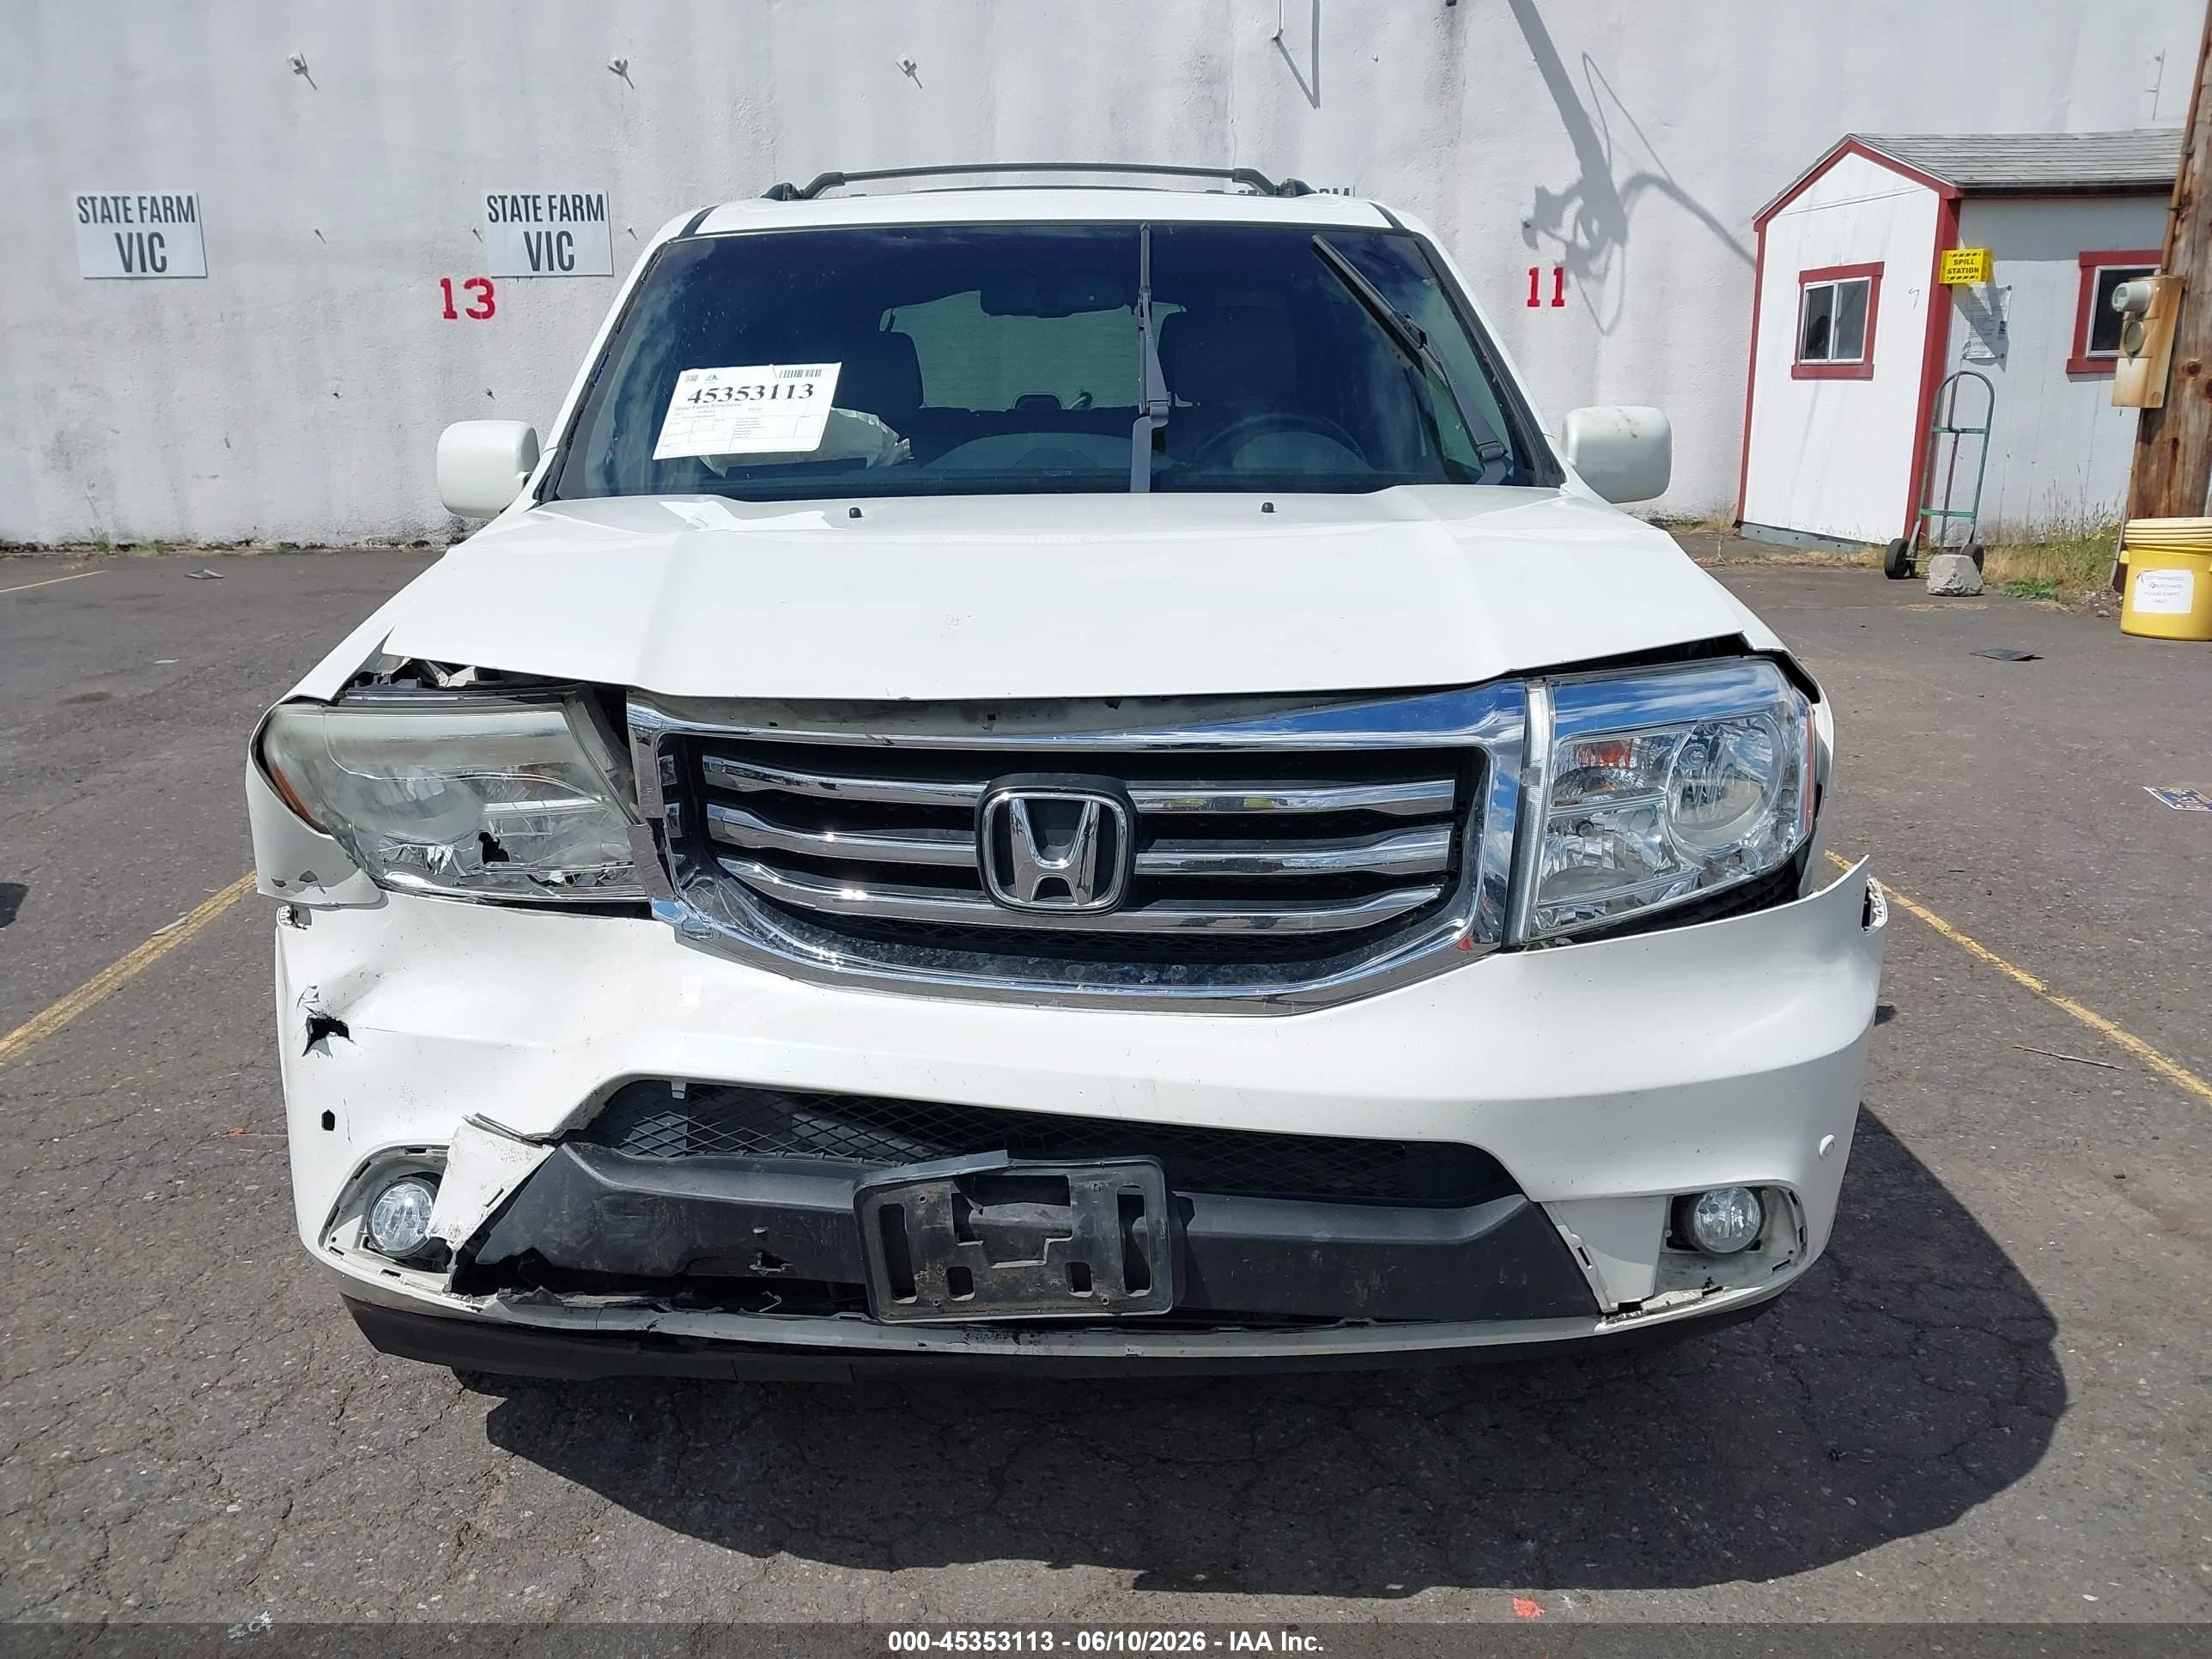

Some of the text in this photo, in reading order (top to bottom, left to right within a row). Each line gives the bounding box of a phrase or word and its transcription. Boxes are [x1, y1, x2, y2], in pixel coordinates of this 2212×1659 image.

[76, 195, 196, 224] STATE FARM
[487, 193, 605, 223] STATE FARM
[114, 231, 167, 273] VIC
[523, 230, 575, 272] VIC
[1527, 266, 1565, 307] 11
[1947, 266, 1979, 275] STATION
[440, 276, 495, 319] 13
[687, 383, 814, 404] 45353113
